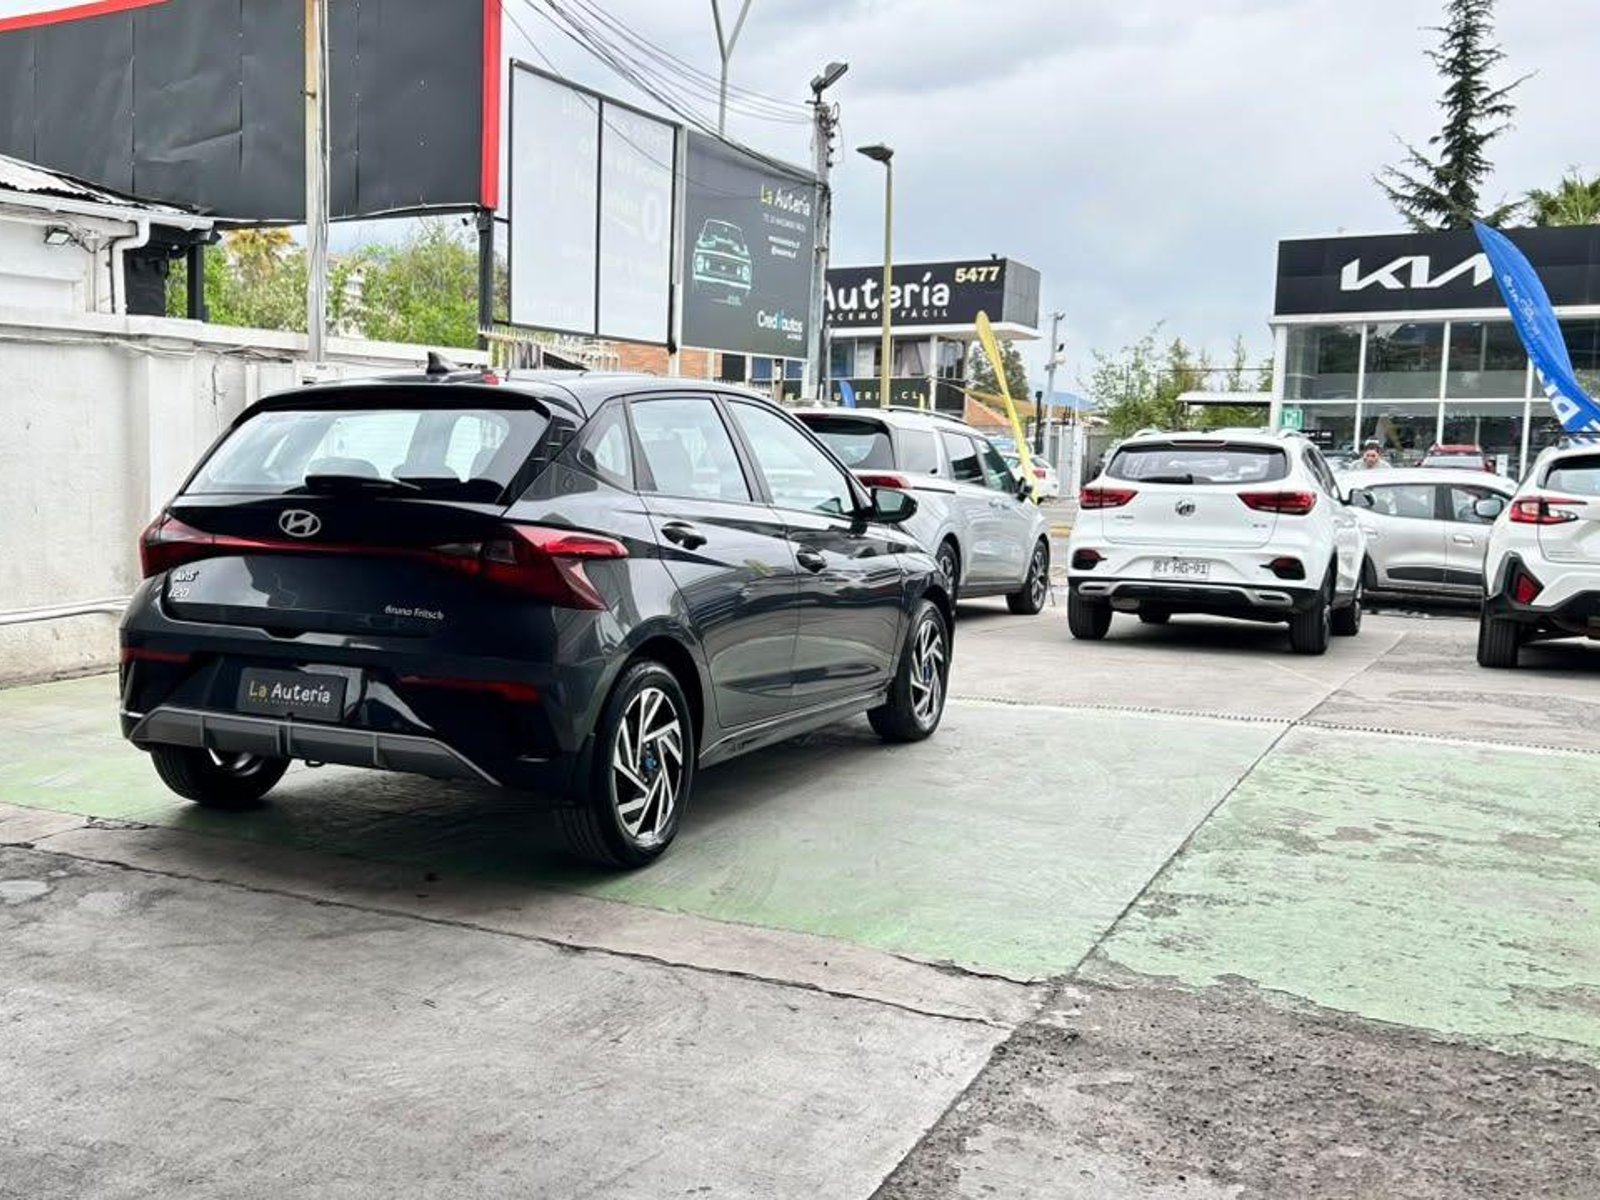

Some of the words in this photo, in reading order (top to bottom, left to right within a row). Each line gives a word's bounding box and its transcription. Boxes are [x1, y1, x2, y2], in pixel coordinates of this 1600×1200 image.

[760, 184, 773, 205] La
[954, 265, 1001, 284] 5477
[1341, 253, 1493, 291] KIA
[826, 311, 879, 322] ACEMO
[384, 603, 413, 616] Bruno
[413, 606, 445, 621] Fritsch
[248, 680, 267, 698] La
[270, 681, 332, 704] Autería
